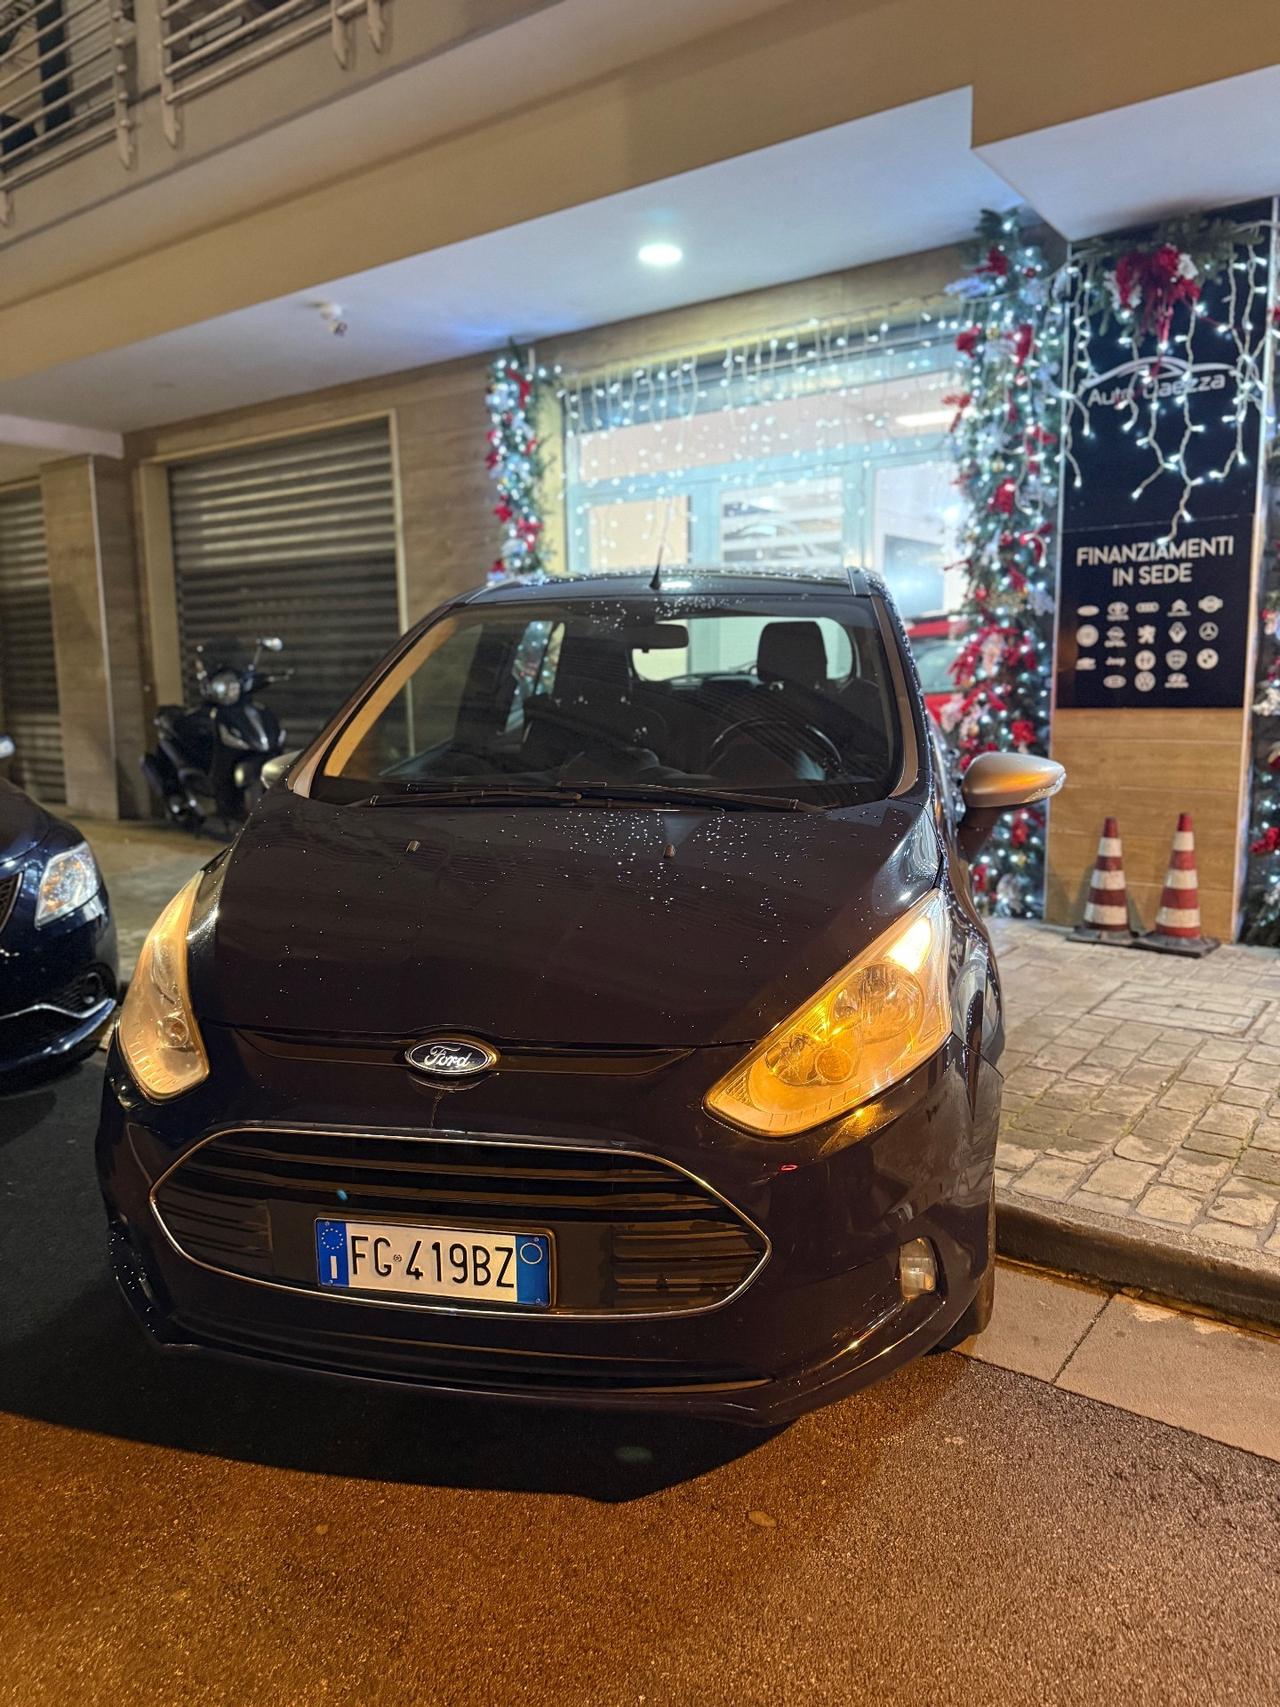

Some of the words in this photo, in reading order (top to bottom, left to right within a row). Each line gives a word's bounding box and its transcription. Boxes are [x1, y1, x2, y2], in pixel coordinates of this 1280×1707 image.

[1076, 535, 1234, 567] FINANZIAMENTI
[1112, 566, 1134, 588] IN
[1138, 562, 1193, 586] SEDE
[424, 1045, 473, 1068] Ford
